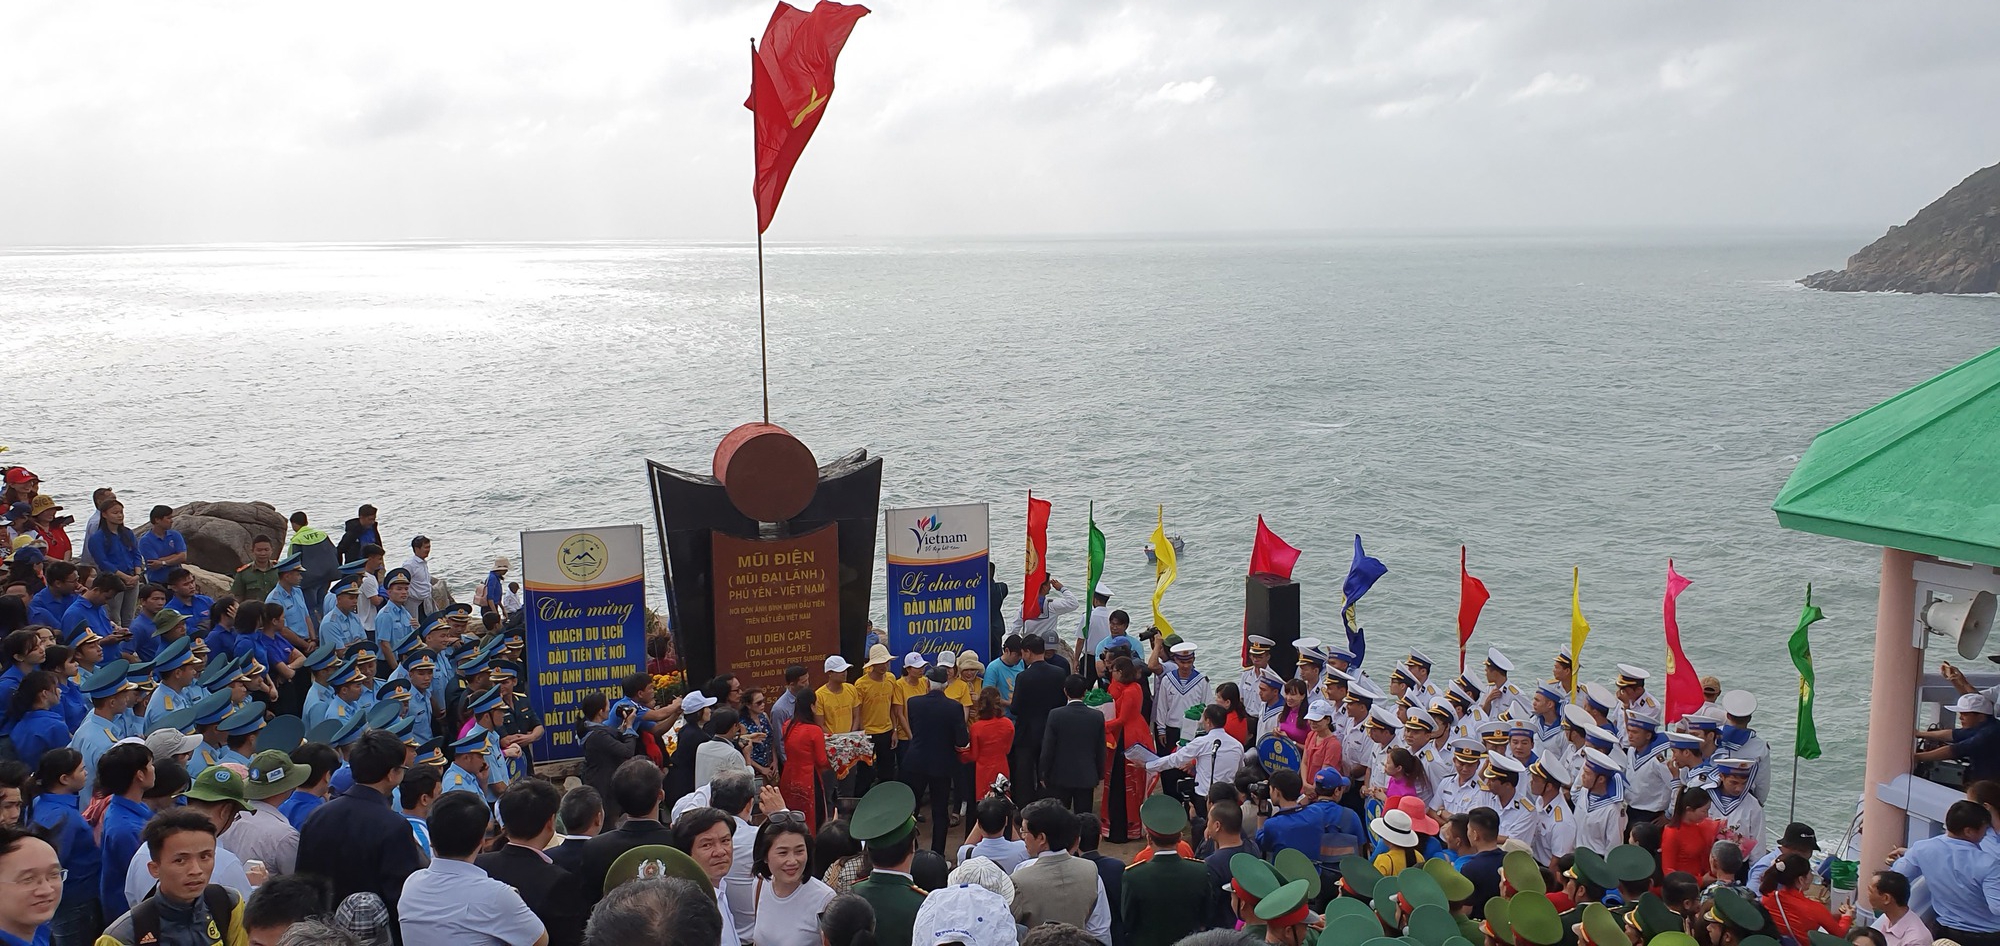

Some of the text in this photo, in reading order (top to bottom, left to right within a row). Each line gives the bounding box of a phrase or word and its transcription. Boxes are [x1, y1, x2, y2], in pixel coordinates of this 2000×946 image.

[303, 532, 318, 540] VFF
[908, 528, 968, 554] Vietnam
[738, 549, 815, 568] MŨI ĐIỆN
[736, 572, 758, 584] MŨI
[762, 572, 782, 584] ĐẠI
[786, 568, 817, 582] LÃNH
[899, 571, 982, 596] Lễ chào cờ
[729, 588, 749, 600] PHÚ
[752, 586, 772, 598] YÊN
[780, 584, 801, 597] VIỆT
[804, 584, 825, 594] NAM
[537, 596, 634, 624] Chào mừng
[904, 594, 975, 616] ĐẦU NĂM MỚI
[549, 625, 624, 644] KHÁCH DU LỊCH
[908, 616, 972, 635] 01/01/2020
[746, 630, 812, 644] MUI DIEN CAPE
[913, 636, 964, 656] Happy
[548, 643, 626, 664] ĐẦU TIÊN VỀ NƠI
[750, 648, 762, 657] DAI
[764, 646, 784, 656] LANH
[786, 644, 806, 654] CAPE
[731, 660, 752, 670] WHERE
[760, 658, 774, 667] PICK
[776, 658, 786, 666] THE
[787, 656, 802, 664] FIRST
[803, 654, 826, 662] SUNRISE
[539, 664, 636, 686] ĐÓN ÁNH BÌNH MINH
[761, 669, 776, 678] LAND
[554, 687, 573, 705] ĐẦU
[544, 708, 564, 726] ĐẤT
[553, 729, 572, 746] PHÚ
